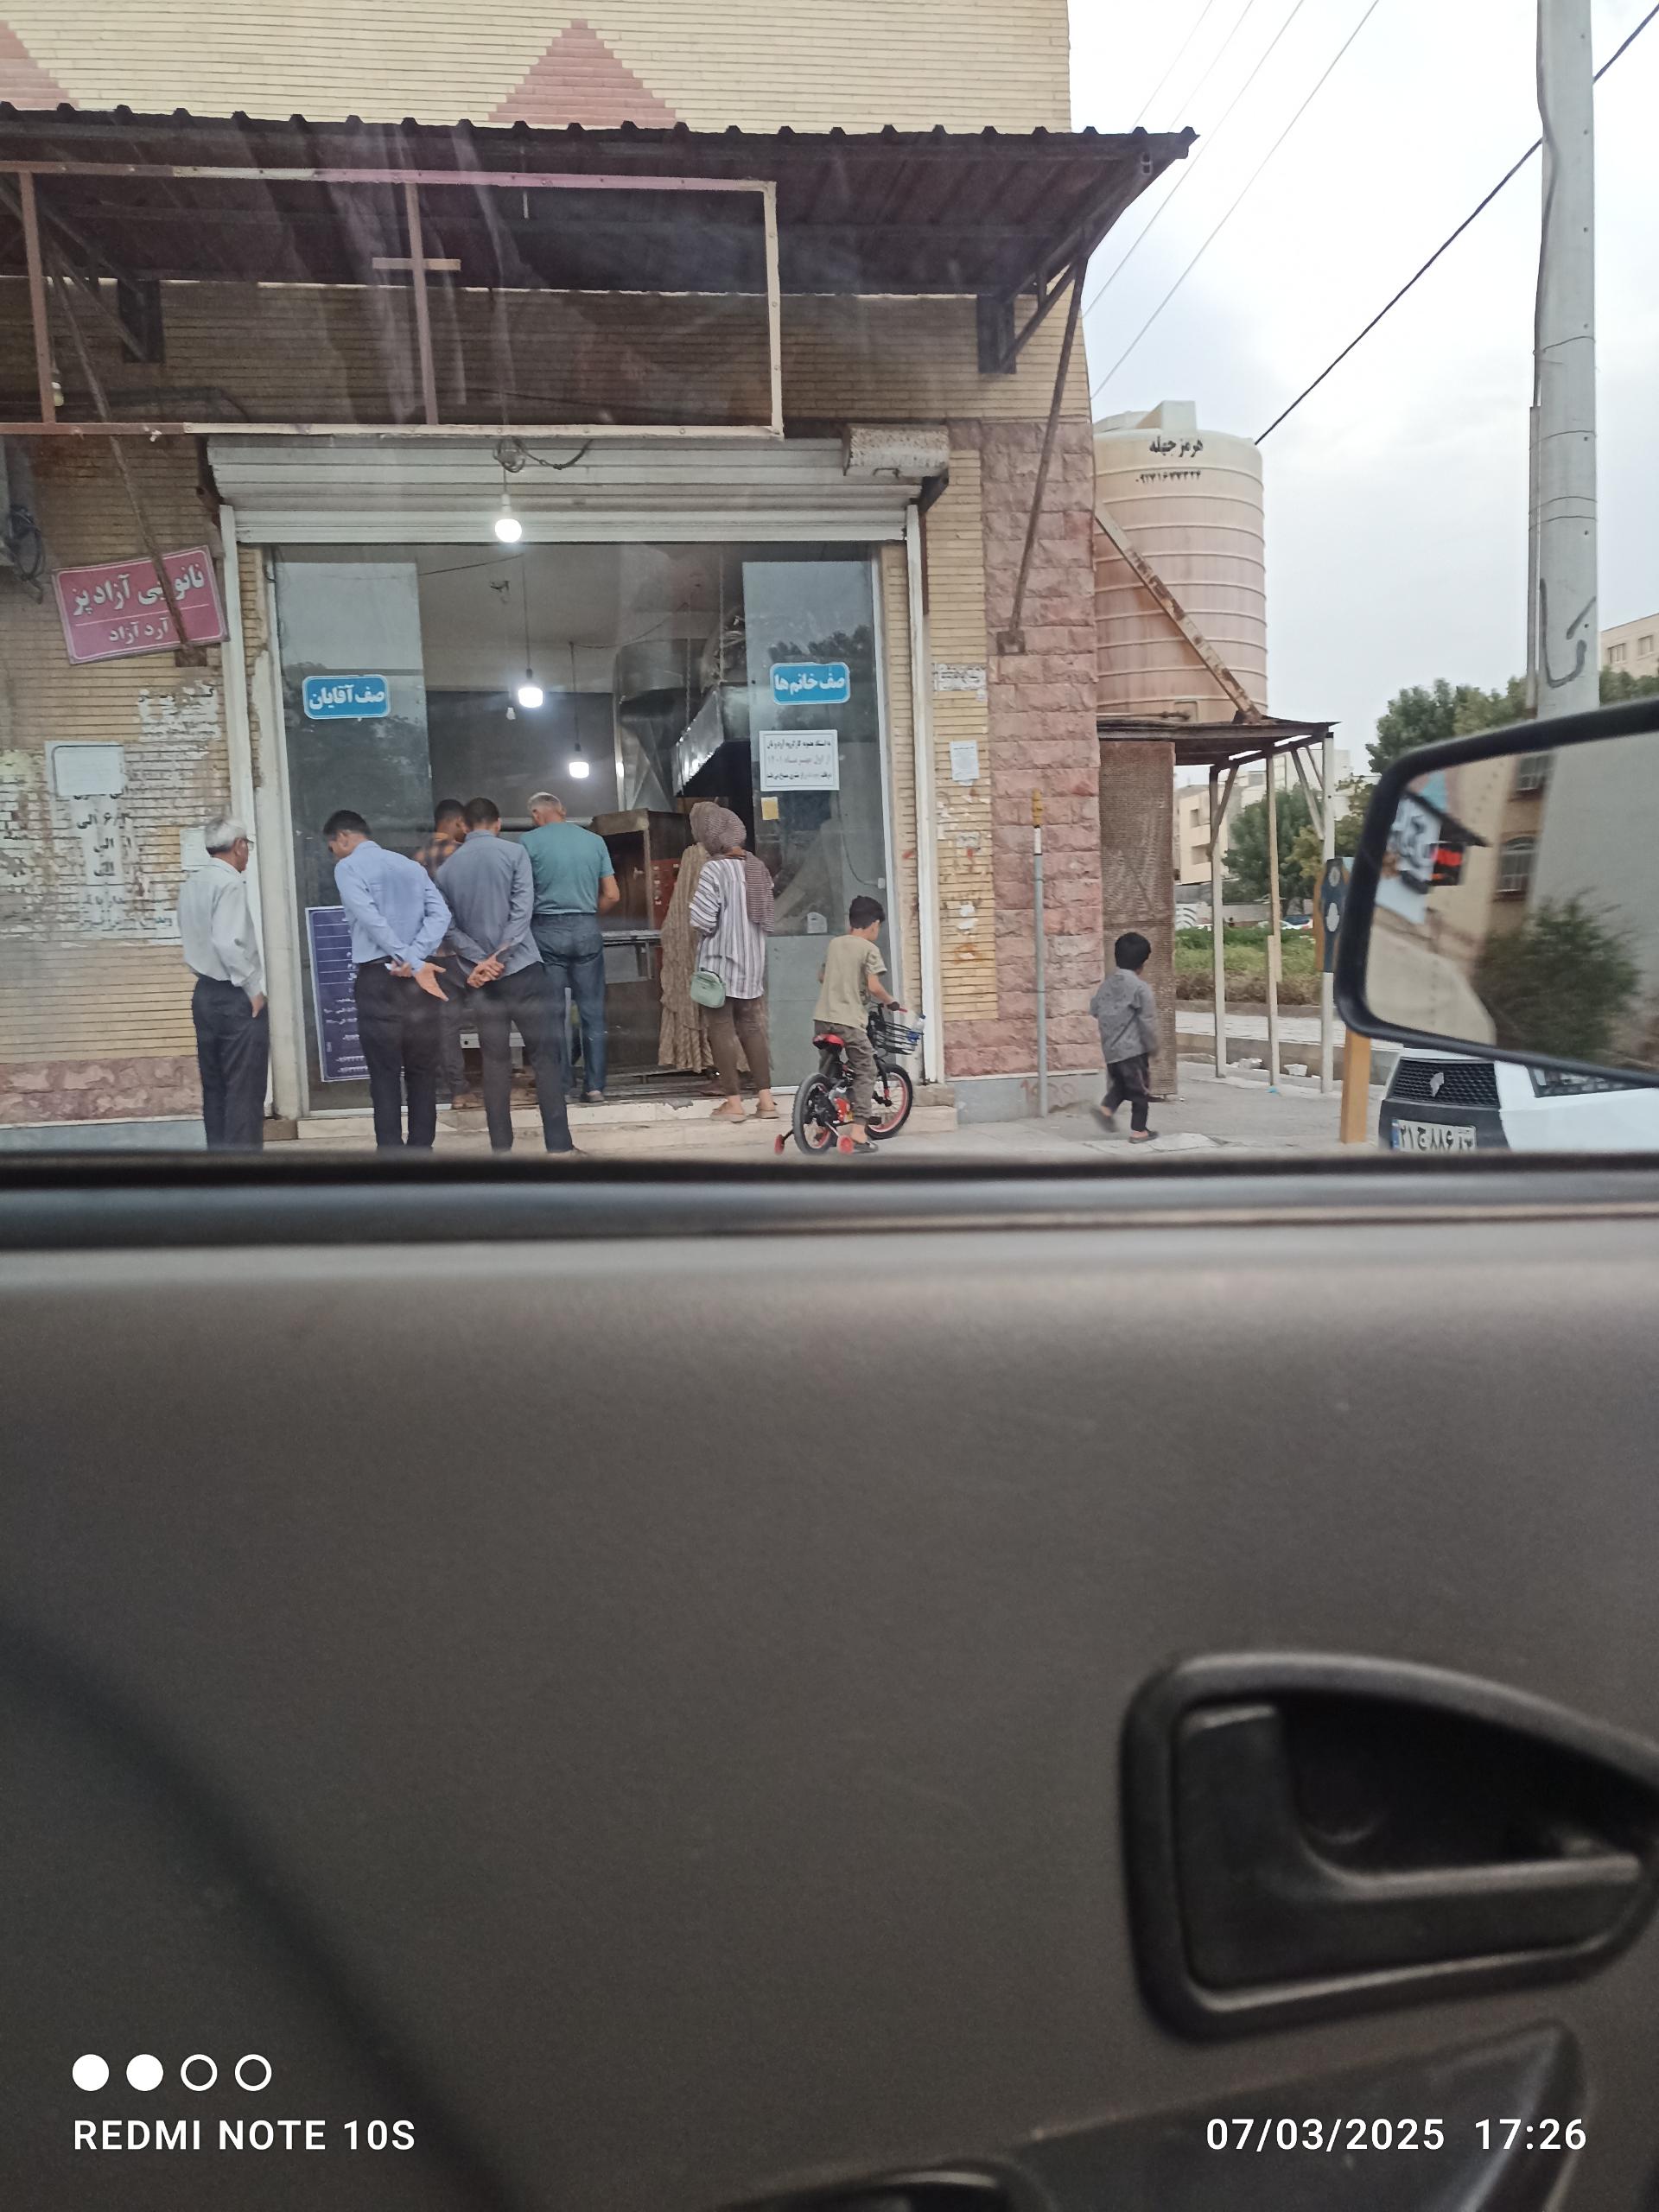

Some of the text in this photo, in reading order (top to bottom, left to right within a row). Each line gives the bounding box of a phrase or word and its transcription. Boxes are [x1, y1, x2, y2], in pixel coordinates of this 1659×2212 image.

[138, 563, 205, 605] نانوی
[109, 617, 169, 645] آرد آزاد
[819, 672, 845, 690] صف
[308, 683, 385, 710] صف آقایان
